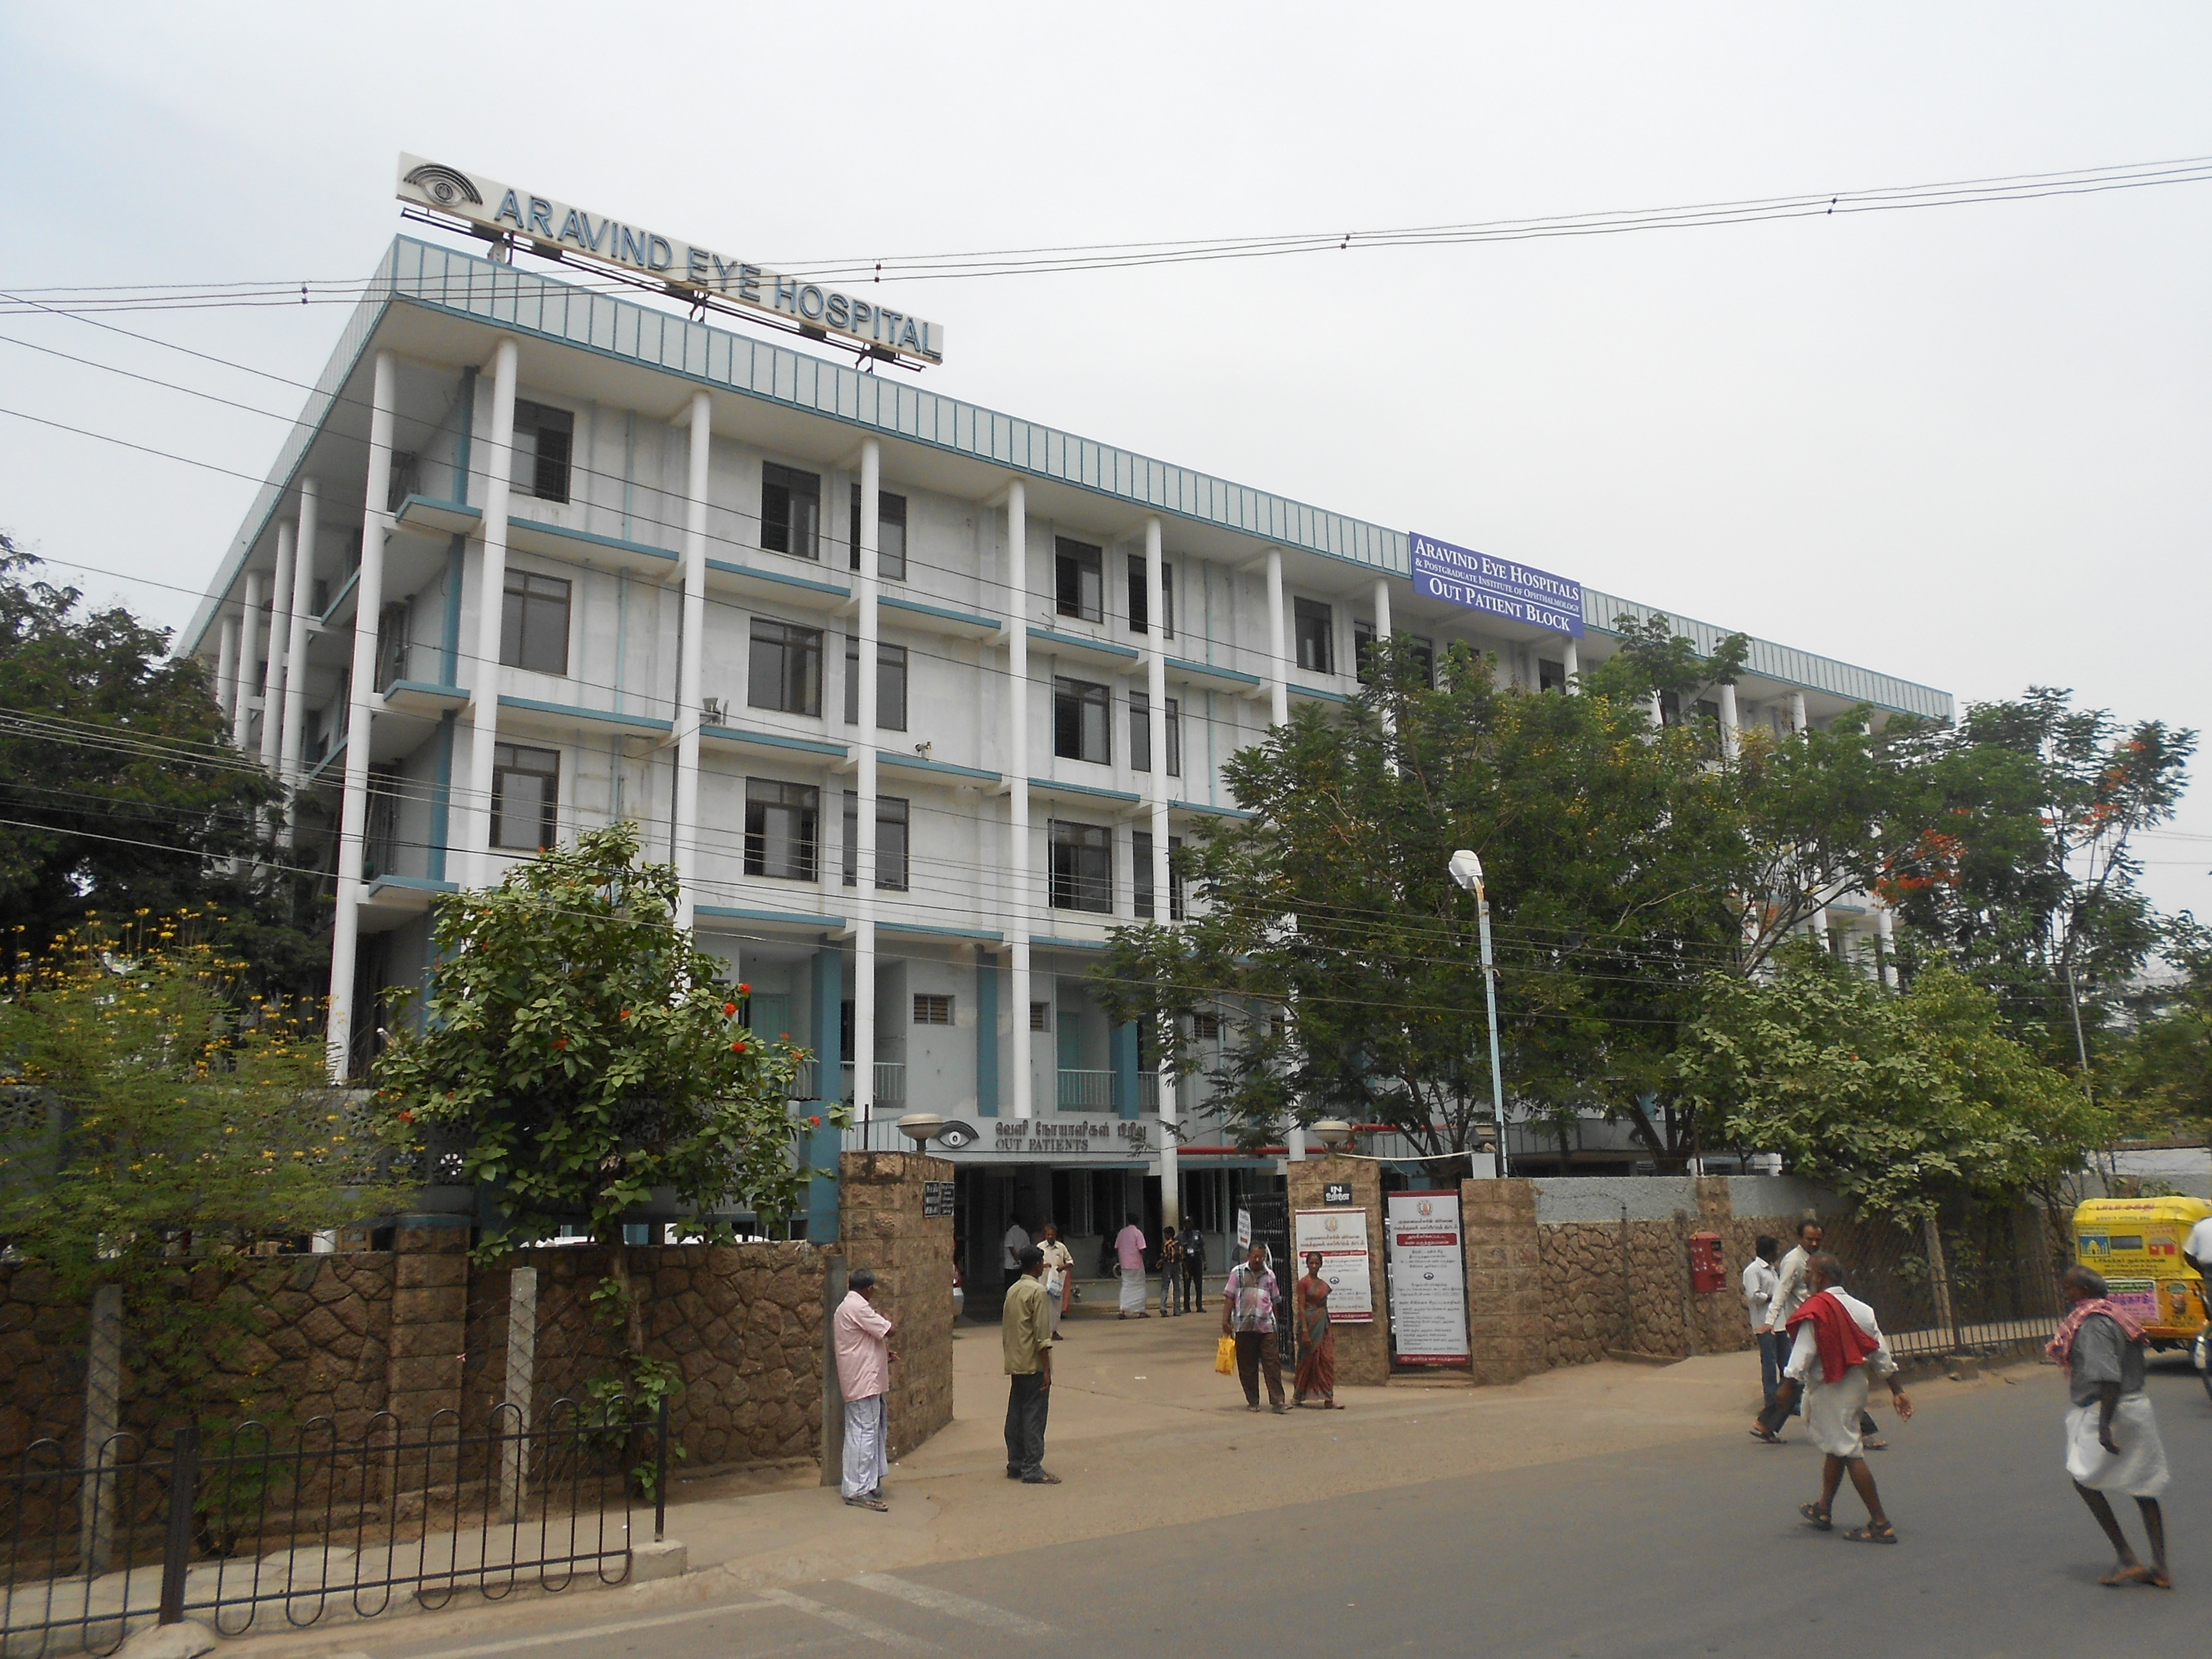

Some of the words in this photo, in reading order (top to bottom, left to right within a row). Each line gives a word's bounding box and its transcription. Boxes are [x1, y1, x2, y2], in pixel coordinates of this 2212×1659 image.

[494, 188, 672, 272] ARAVIND
[687, 245, 761, 302] EYE
[774, 275, 942, 361] HOSPITAL
[1415, 538, 1478, 571] ARAVIND
[1510, 565, 1579, 601] HOSPITALS
[1415, 558, 1422, 567] &
[1424, 560, 1478, 584] POSTGRADUATE
[1429, 577, 1462, 602] OUT
[1465, 587, 1523, 617] PATIENT
[1526, 603, 1571, 632] BLOCK
[996, 1139, 1022, 1150] OUT
[1029, 1138, 1088, 1151] PATIENTS
